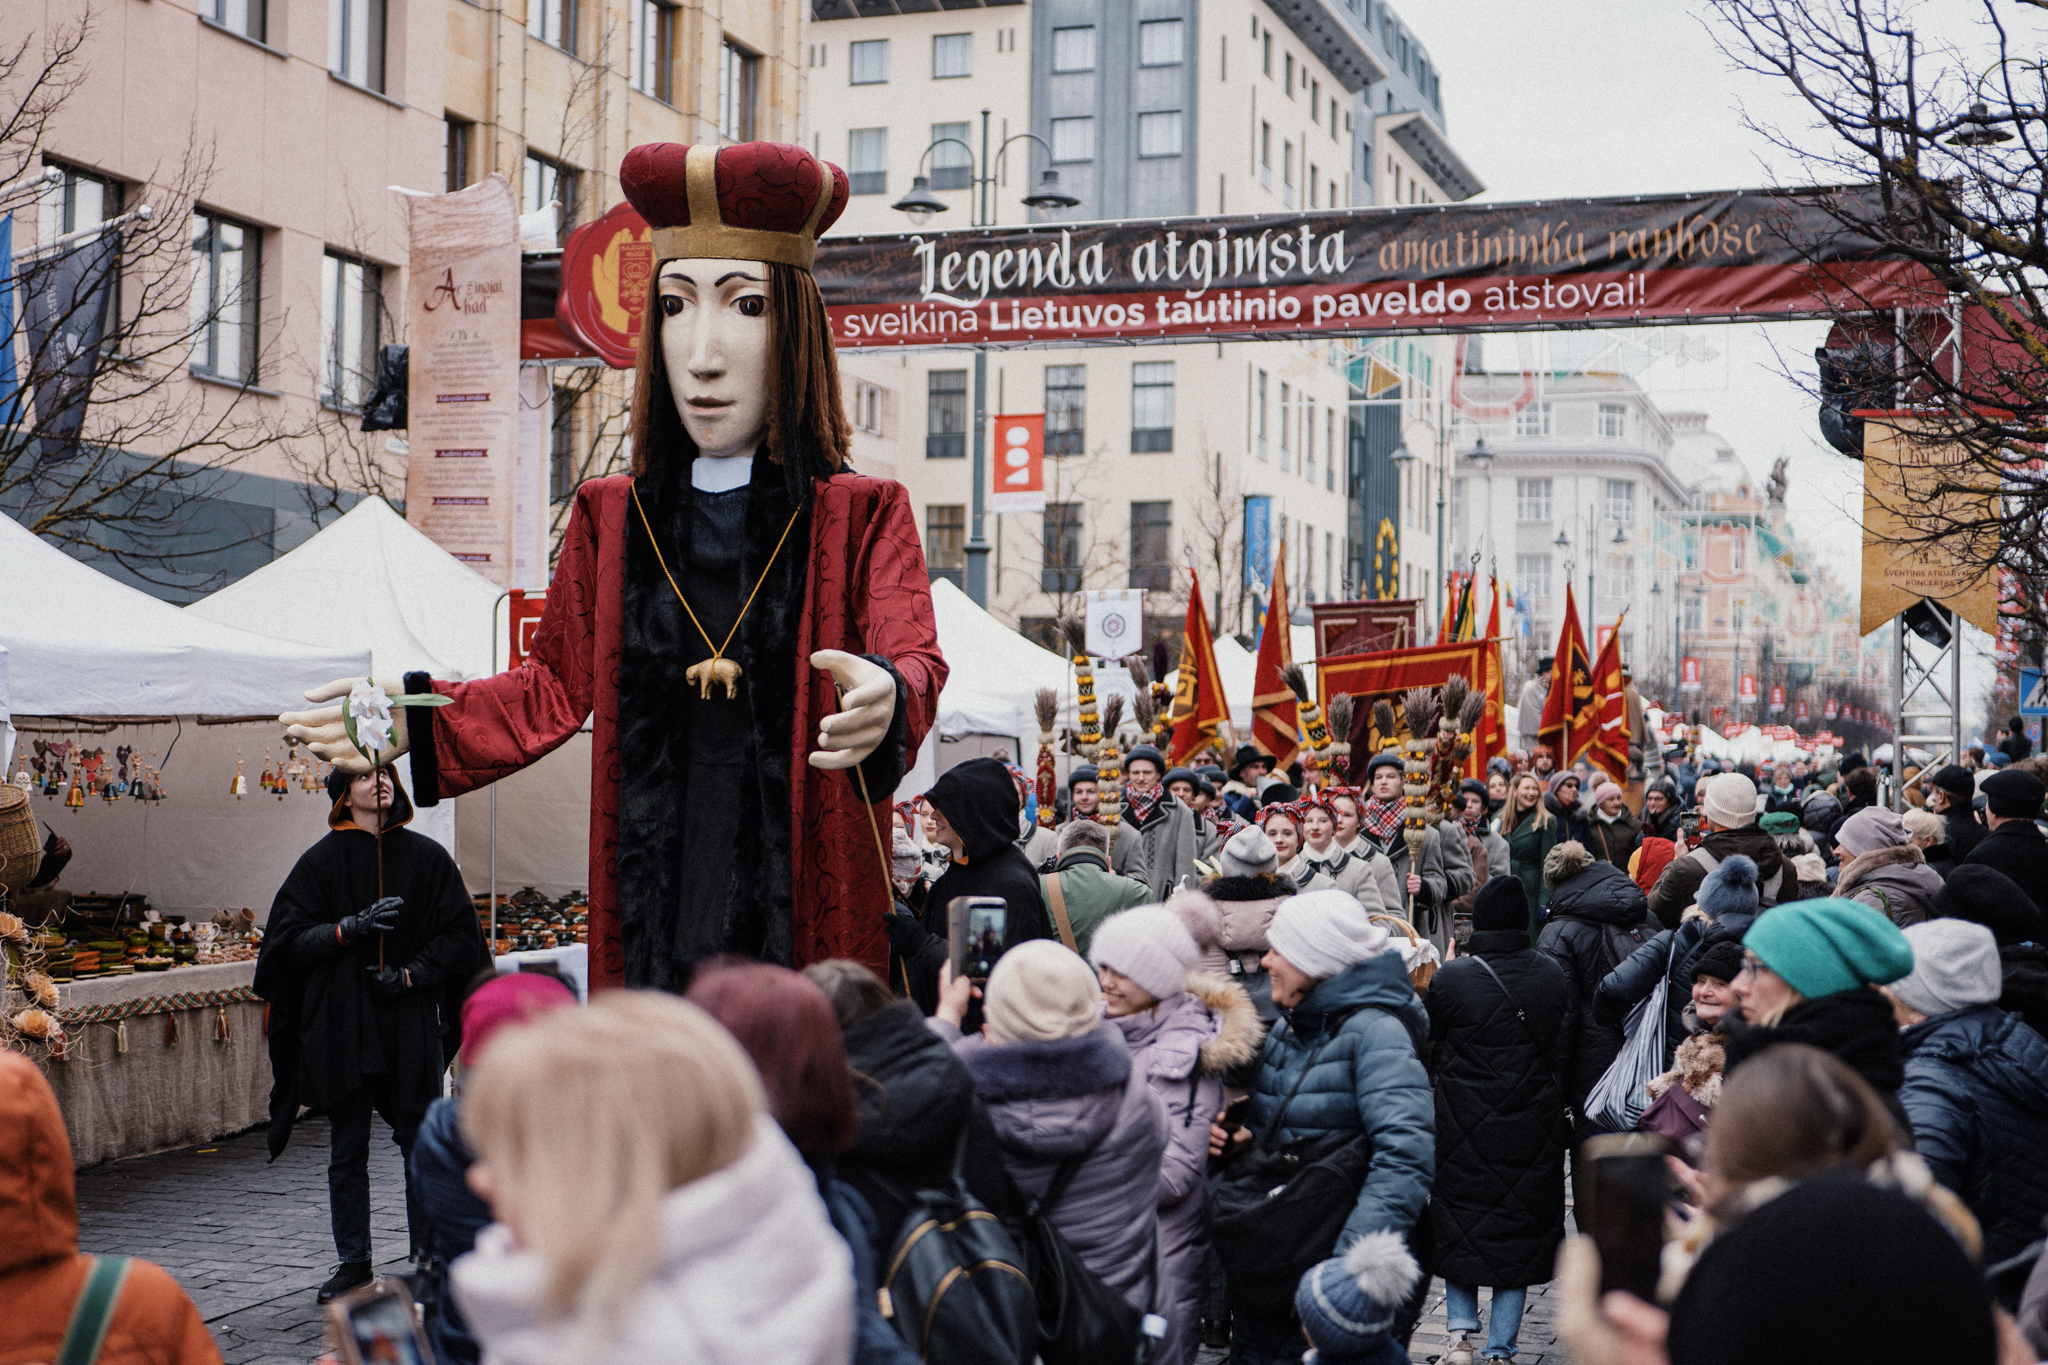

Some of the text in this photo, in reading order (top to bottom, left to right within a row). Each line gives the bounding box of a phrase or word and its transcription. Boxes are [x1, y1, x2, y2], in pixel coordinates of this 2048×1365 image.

[909, 228, 1113, 308] Legenda
[1131, 224, 1355, 299] atgimsta
[1608, 213, 1768, 261] rankose
[844, 302, 978, 338] sveikina
[990, 299, 1146, 331] Lietuvos
[1156, 288, 1301, 325] tautinio
[1313, 281, 1472, 327] paveldo
[1484, 272, 1646, 311] atstovai!
[1884, 567, 1925, 577] ŠVENTINIS
[1906, 579, 1955, 588] KONCERTAS
